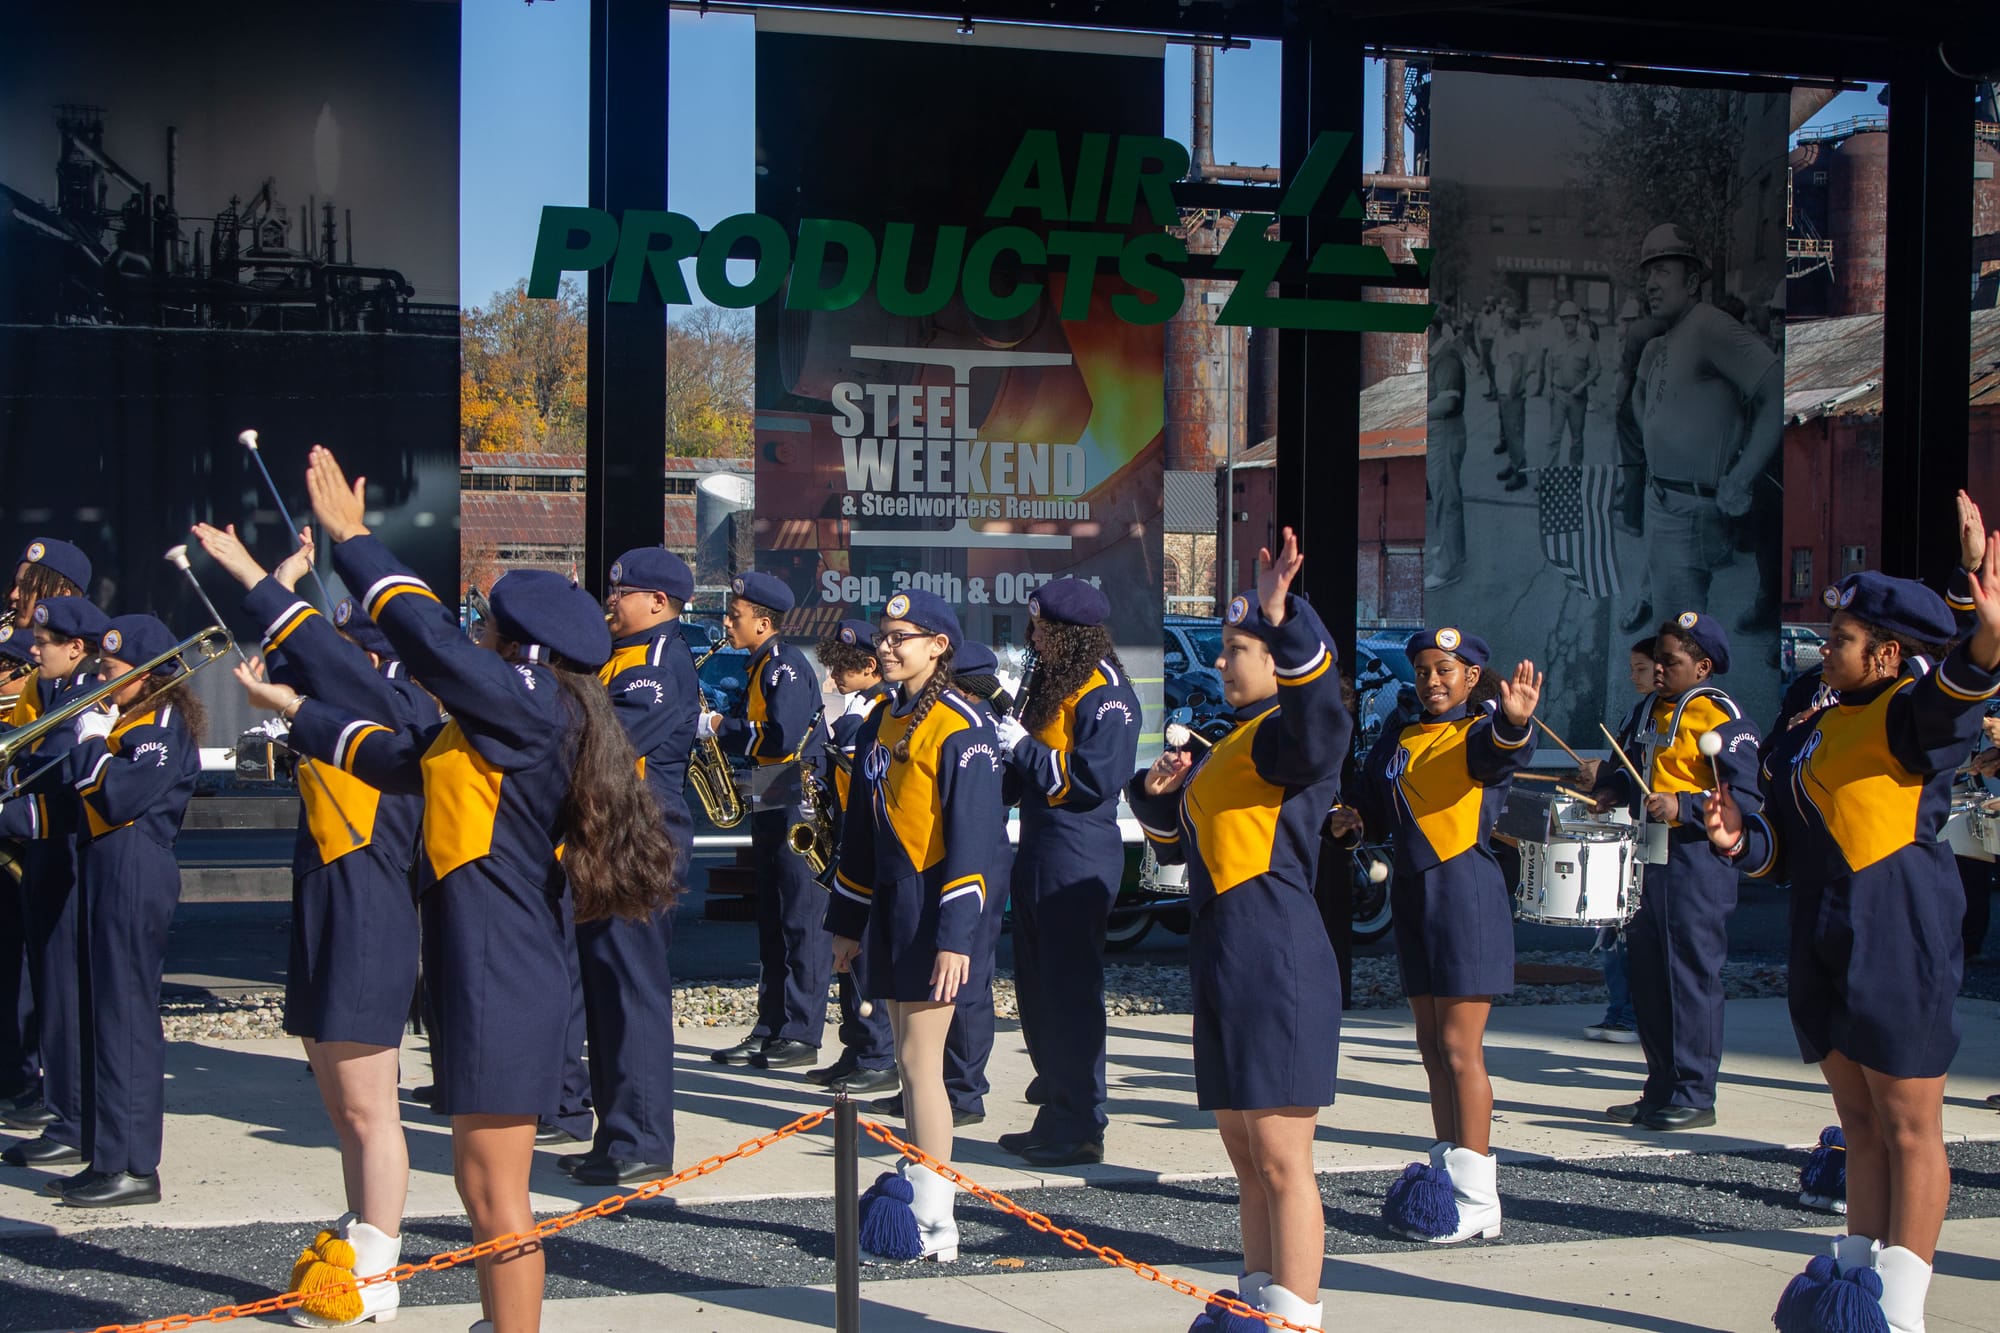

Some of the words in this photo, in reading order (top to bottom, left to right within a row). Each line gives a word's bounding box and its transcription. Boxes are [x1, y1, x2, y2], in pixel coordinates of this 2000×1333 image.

[984, 129, 1191, 227] AIR
[527, 205, 1189, 325] PRODUCTS
[831, 382, 978, 439] STEEL
[841, 438, 1087, 495] WEEKEND
[842, 495, 857, 516] &
[861, 493, 1000, 518] Steelworkers
[1006, 496, 1090, 520] Reunion
[821, 570, 887, 605] Sep.
[968, 577, 990, 604] &
[624, 679, 664, 704] ROUGHAL
[1096, 701, 1133, 725] BROUGHAL
[959, 743, 999, 772] BROUGHAL
[1729, 733, 1760, 753] BROUGHA
[1526, 858, 1536, 901] YAMAHA
